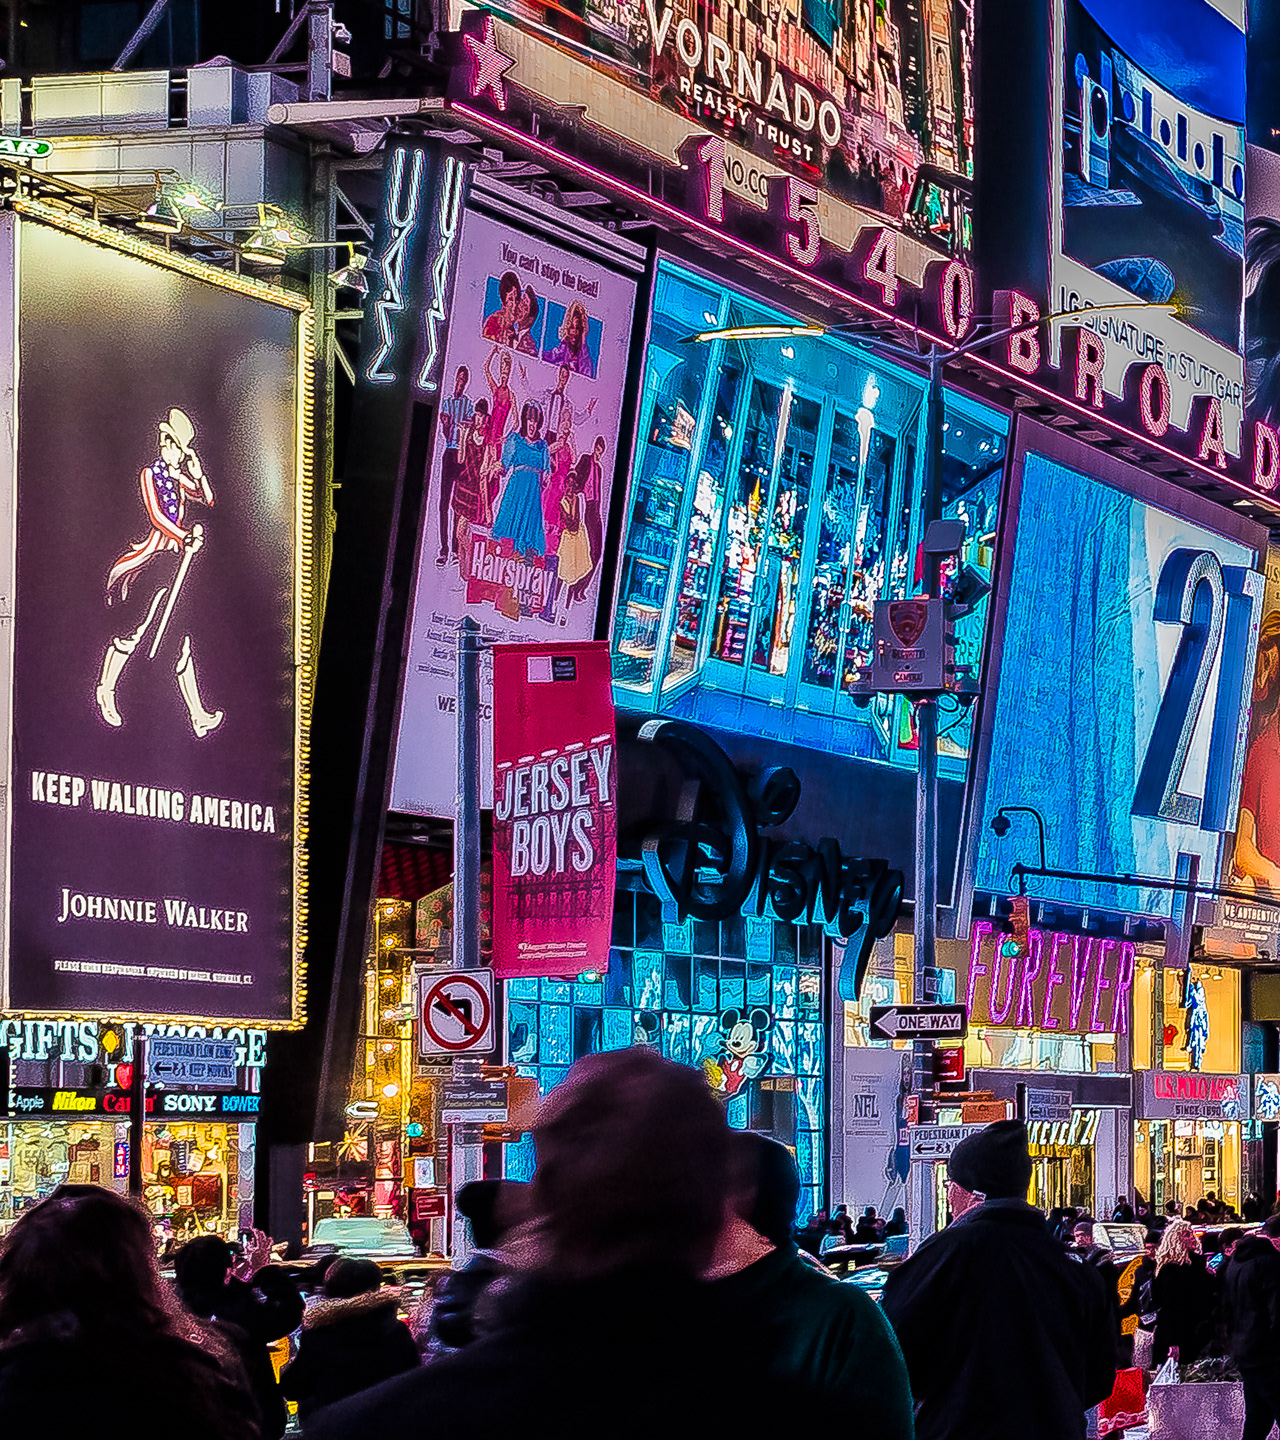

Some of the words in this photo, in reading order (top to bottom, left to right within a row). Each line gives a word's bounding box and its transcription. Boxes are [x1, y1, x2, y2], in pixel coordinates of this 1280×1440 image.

[680, 76, 750, 136] REALTY
[755, 116, 814, 162] TRUST
[471, 540, 555, 613] Hairspray
[496, 743, 613, 821] JERSEY
[31, 771, 86, 807] KEEP
[91, 778, 185, 822] WALKING
[190, 795, 276, 834] AMERICA
[510, 807, 595, 879] BOYS
[966, 920, 1136, 1034] FOREVER
[899, 1014, 926, 1029] ONE
[929, 1014, 958, 1030] WAY
[0, 1020, 99, 1061] GIFTS
[16, 1097, 45, 1111] Apple
[53, 1091, 97, 1111] Nikon
[164, 1095, 217, 1112] SONY
[1176, 1076, 1208, 1101] POLO
[853, 1093, 880, 1118] NFL
[914, 1128, 961, 1142] PEDESTRIAN
